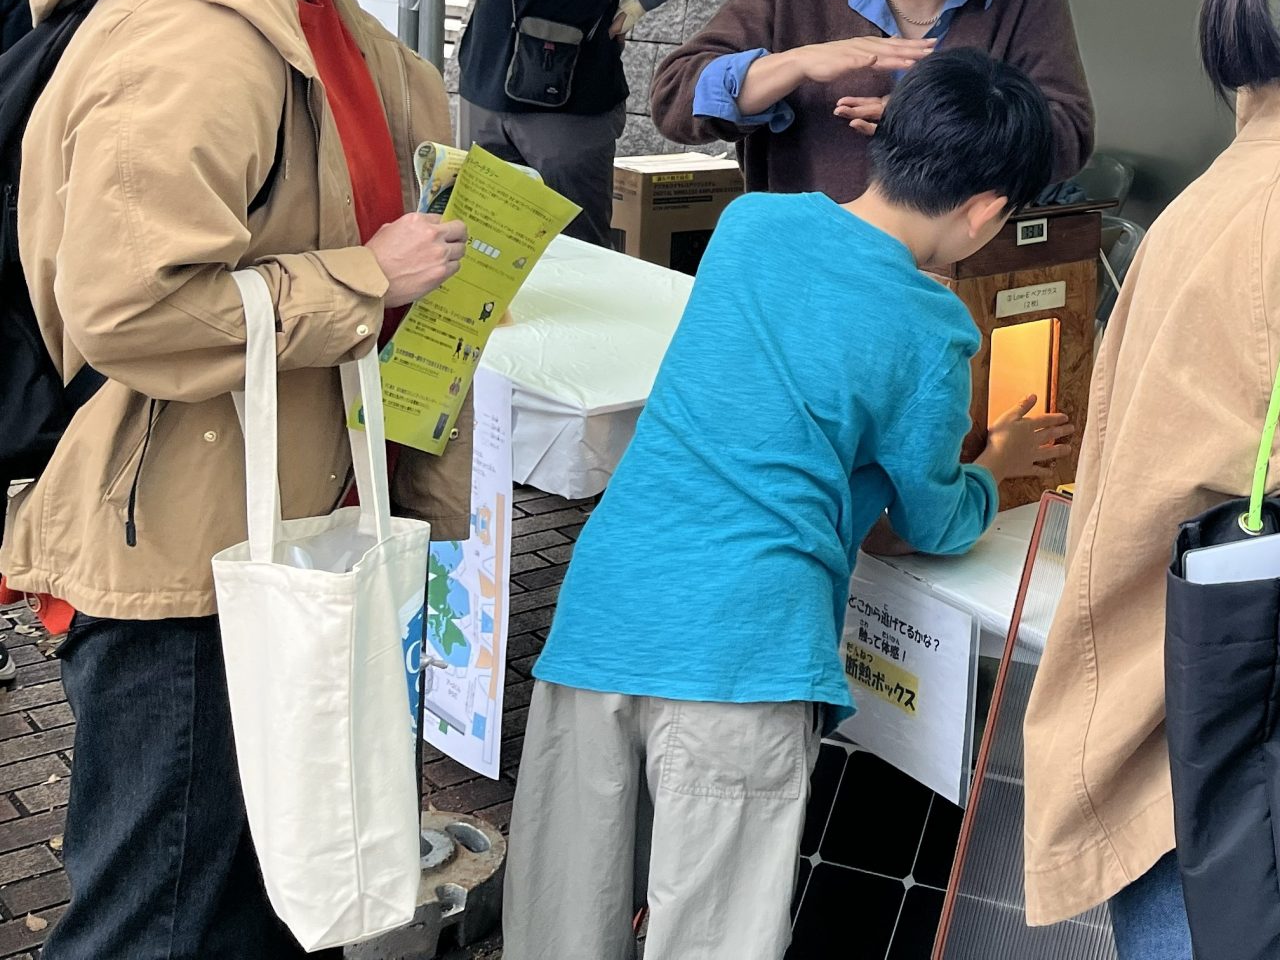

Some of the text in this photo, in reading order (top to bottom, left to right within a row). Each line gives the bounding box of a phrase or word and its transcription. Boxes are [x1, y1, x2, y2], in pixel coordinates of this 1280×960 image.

[845, 655, 916, 712] 断熱ボックス
